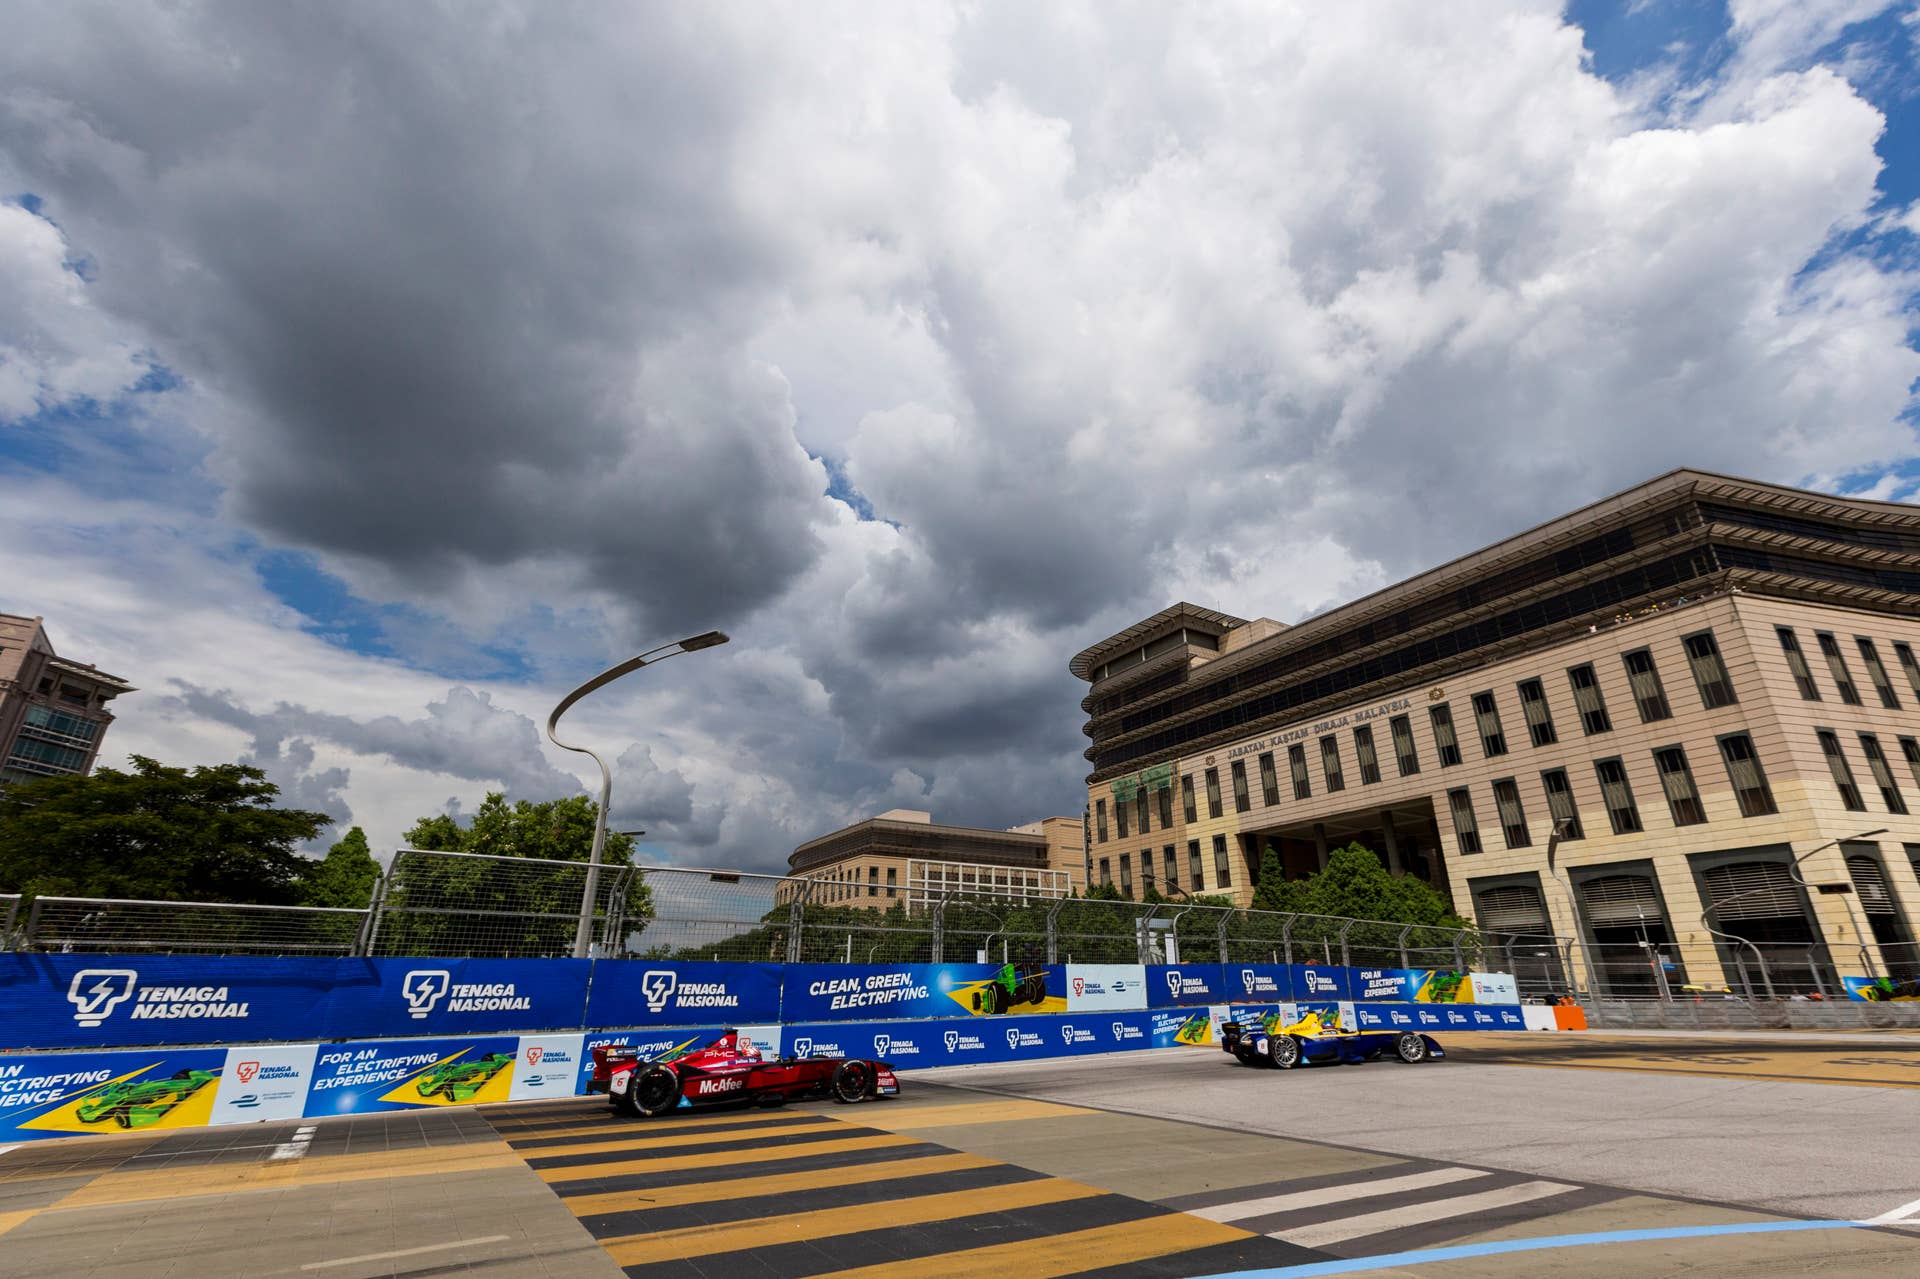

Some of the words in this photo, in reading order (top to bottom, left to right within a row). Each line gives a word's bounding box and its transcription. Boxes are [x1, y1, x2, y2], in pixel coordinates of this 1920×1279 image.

[1227, 741, 1266, 759] JABATAN
[1270, 728, 1309, 747] KASTAM
[1313, 717, 1350, 735] DIRAJA
[1354, 699, 1412, 723] MALAYSIA
[1182, 978, 1203, 986] TENAGA
[1361, 971, 1373, 980] FOR
[1373, 970, 1382, 978] AN
[451, 983, 515, 998] TENAGA
[677, 983, 726, 996] TENAGA
[809, 978, 861, 996] CLEAN,
[865, 972, 913, 989] GREEN,
[1183, 986, 1209, 994] NASIONAL
[137, 986, 229, 1002] TENAGA
[675, 995, 738, 1008] NASIONAL
[830, 985, 930, 1010] ELECTRIFYING.
[130, 1003, 249, 1019] NASIONAL
[447, 997, 530, 1012] NASIONAL
[613, 1036, 629, 1046] AN
[637, 1041, 673, 1054] IFYING
[959, 1042, 985, 1050] NASIONAL
[319, 1051, 353, 1065] FOR
[353, 1048, 378, 1061] AN
[890, 1047, 920, 1055] NASIONAL
[336, 1053, 438, 1075] ELECTRIFYING
[258, 1072, 299, 1080] NASIONAL
[313, 1068, 408, 1091] EXPERIENCE.
[616, 1078, 626, 1087] 6
[699, 1077, 743, 1094] McAfee
[0, 1088, 64, 1107] IENCE.
